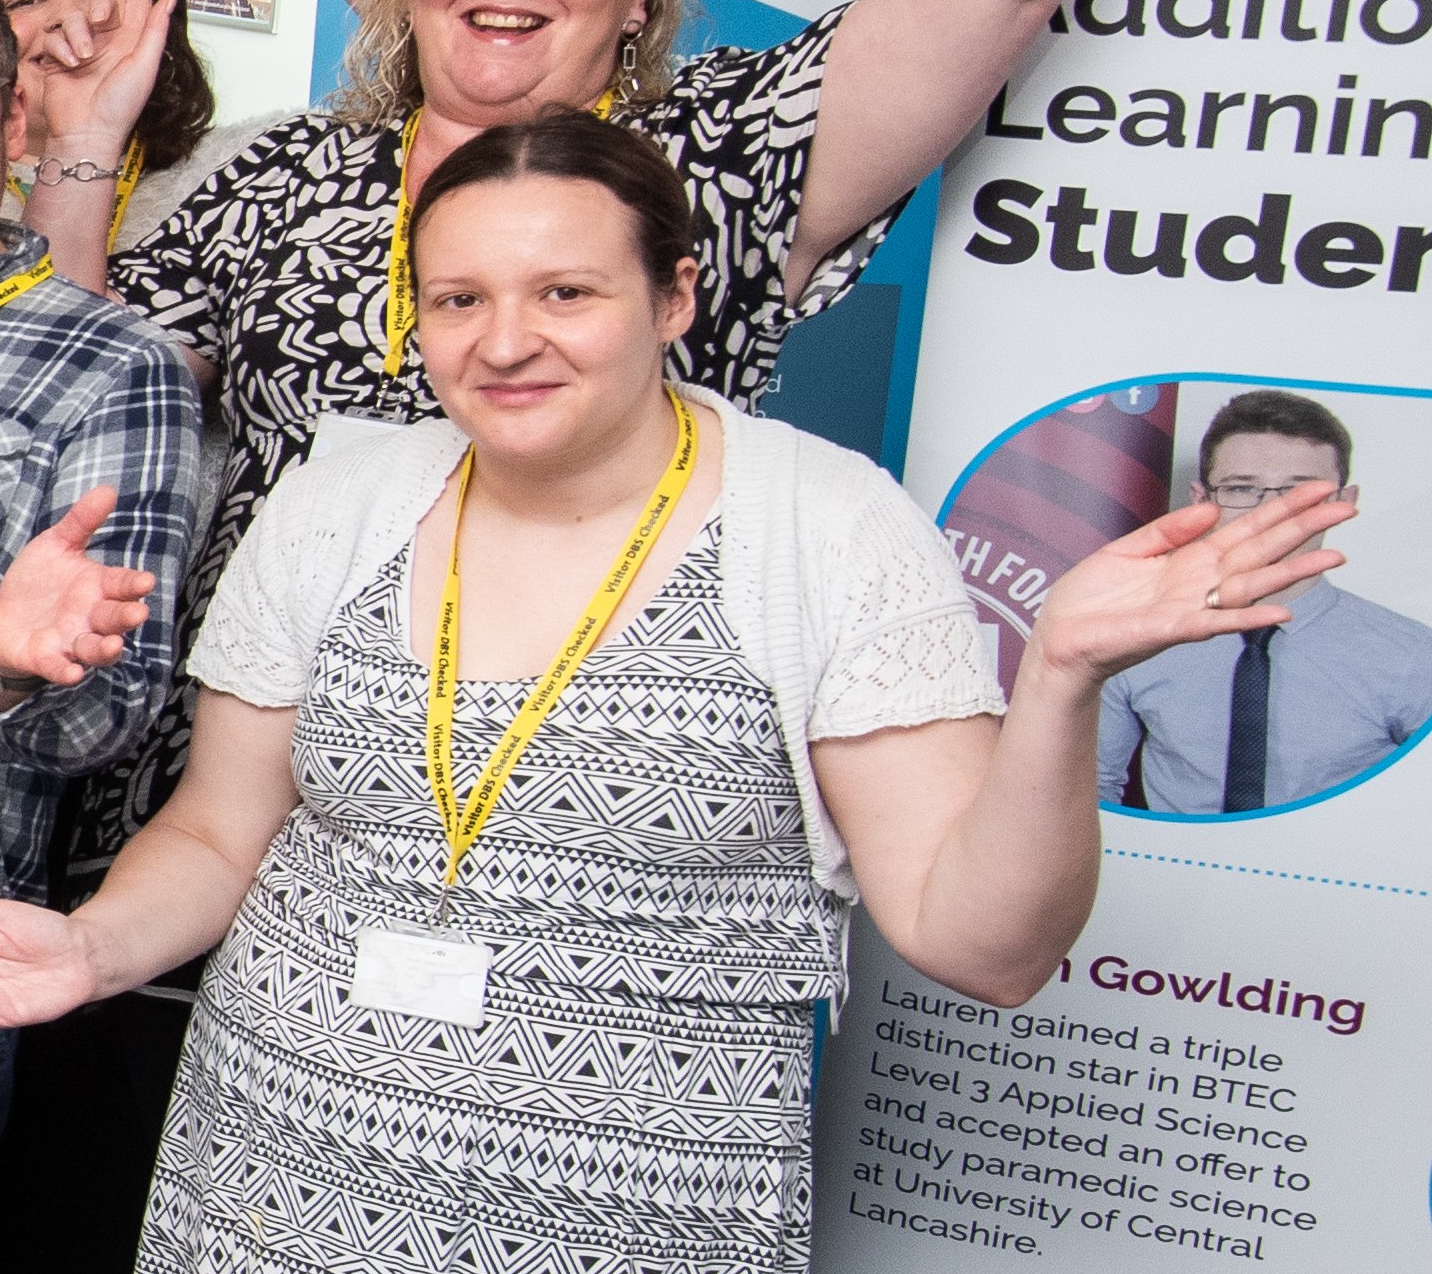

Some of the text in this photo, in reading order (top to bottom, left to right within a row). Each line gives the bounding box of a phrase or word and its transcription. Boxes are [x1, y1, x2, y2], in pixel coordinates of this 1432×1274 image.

[393, 257, 407, 332] Visitor DBS Checked
[603, 493, 671, 593] Visitor DBS Checked
[435, 601, 454, 699] Visitor DBS Checked
[528, 615, 597, 712] Visitor DBS Checked
[461, 733, 522, 836] Visitor DBS Checked
[881, 980, 1284, 1073] Lauren gained a triple
[1088, 954, 1366, 1035] Gowlding
[870, 1053, 1309, 1154] Level 3 Applied Science
[875, 1017, 1296, 1113] distinction star in BTEC
[858, 1128, 1316, 1232] study paramedic science
[864, 1093, 1310, 1192] and accepted an offer to
[848, 1193, 1043, 1256] Lancashire.
[854, 1160, 1263, 1260] at University of Central
